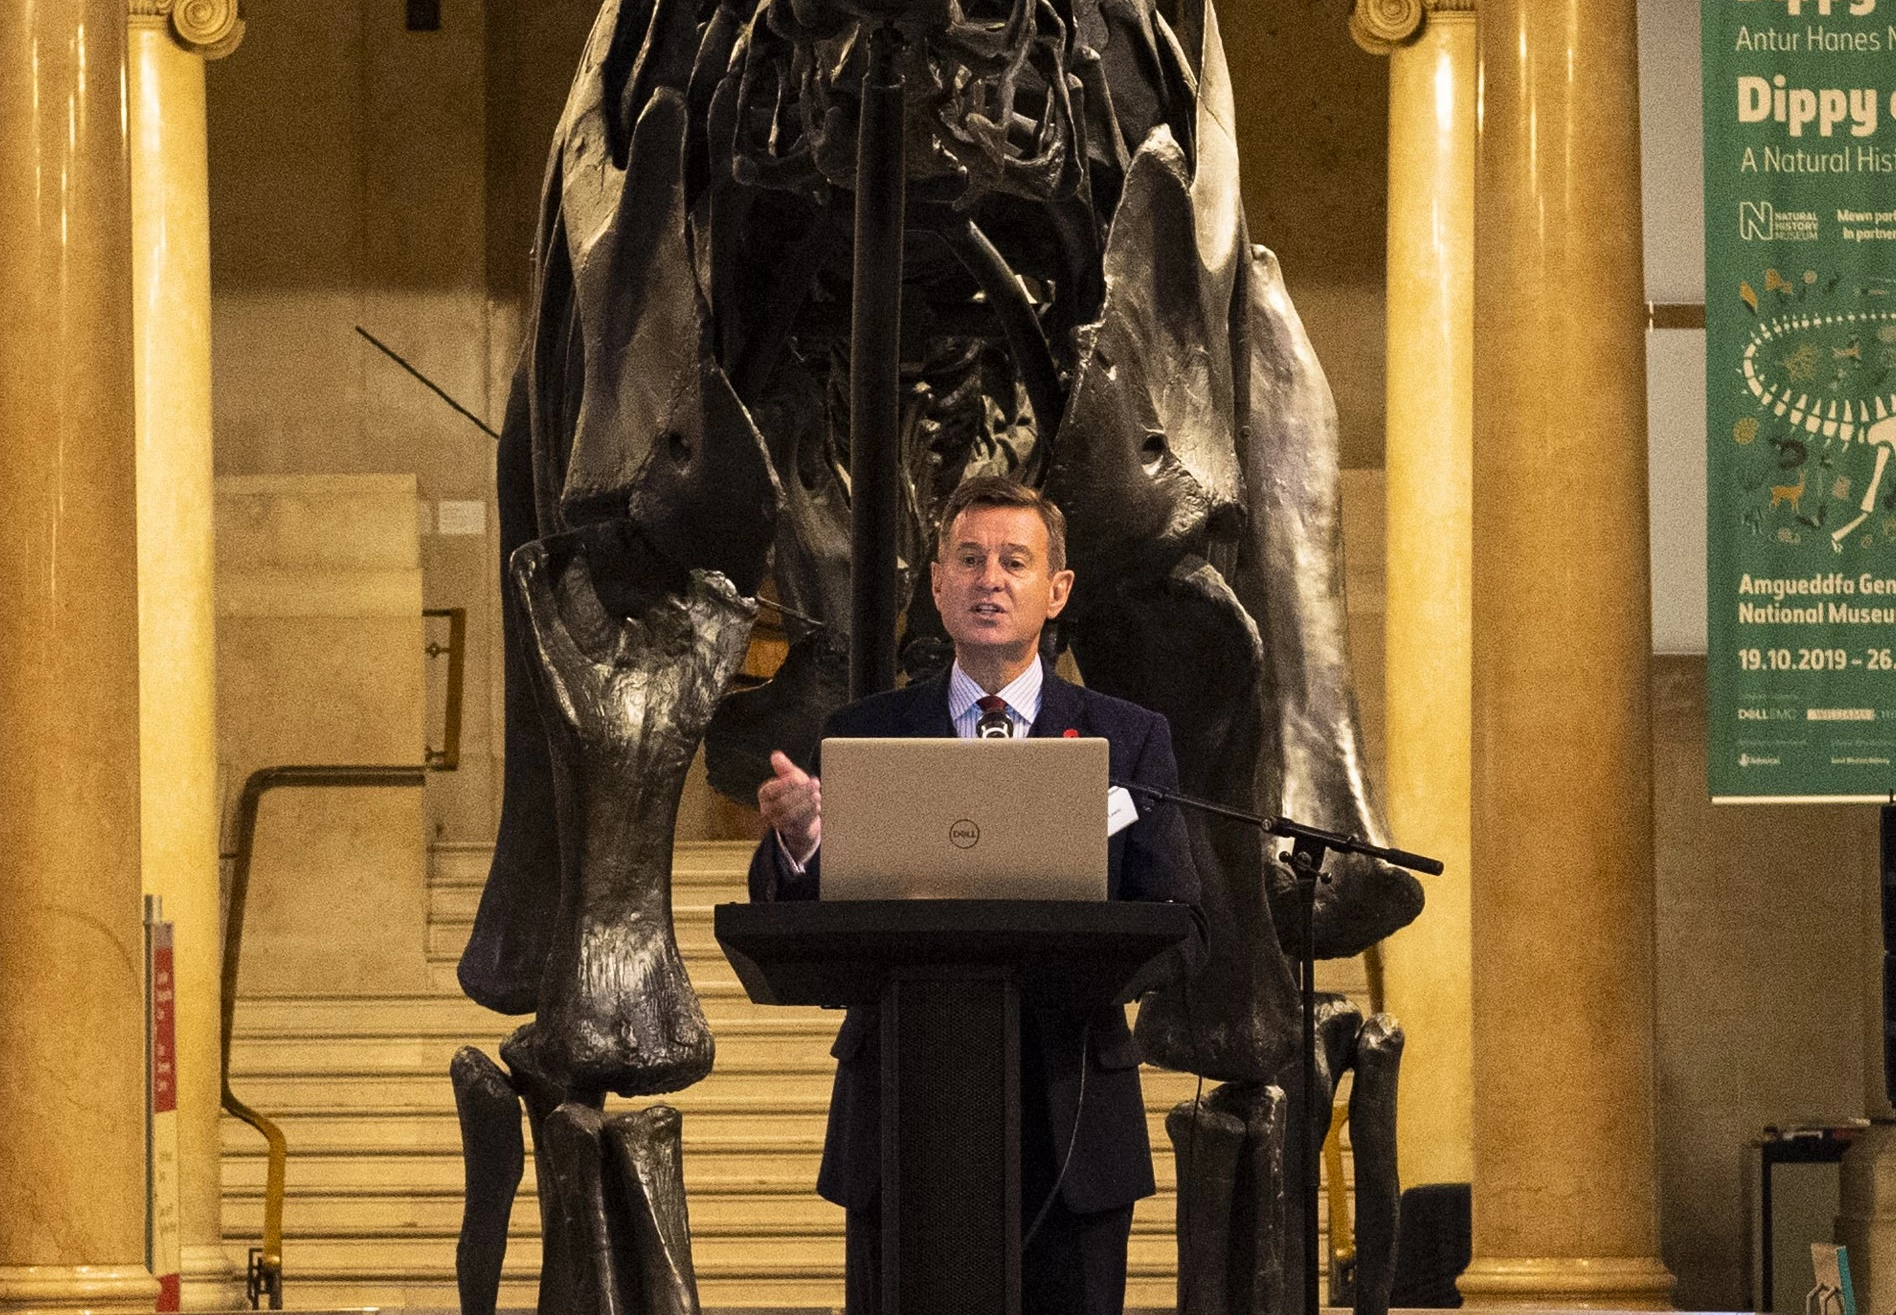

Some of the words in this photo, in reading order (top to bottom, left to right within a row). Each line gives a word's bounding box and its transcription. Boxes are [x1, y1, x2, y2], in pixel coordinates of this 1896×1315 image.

[1735, 25, 1800, 51] Antur
[1807, 25, 1880, 51] Hanes
[1737, 74, 1878, 137] Dippy
[1740, 147, 1758, 173] A
[1764, 146, 1850, 172] Natural
[1857, 146, 1896, 172] His
[1774, 212, 1818, 221] NATURAL
[1775, 222, 1818, 230] HISTORY
[1837, 209, 1873, 222] Mewn
[1739, 573, 1855, 600] Amgueddfa
[1859, 573, 1896, 594] Gen
[1738, 602, 1824, 623] National
[1828, 602, 1895, 623] Museu
[1738, 648, 1847, 670] 19.10.2019
[953, 830, 975, 838] DELL
